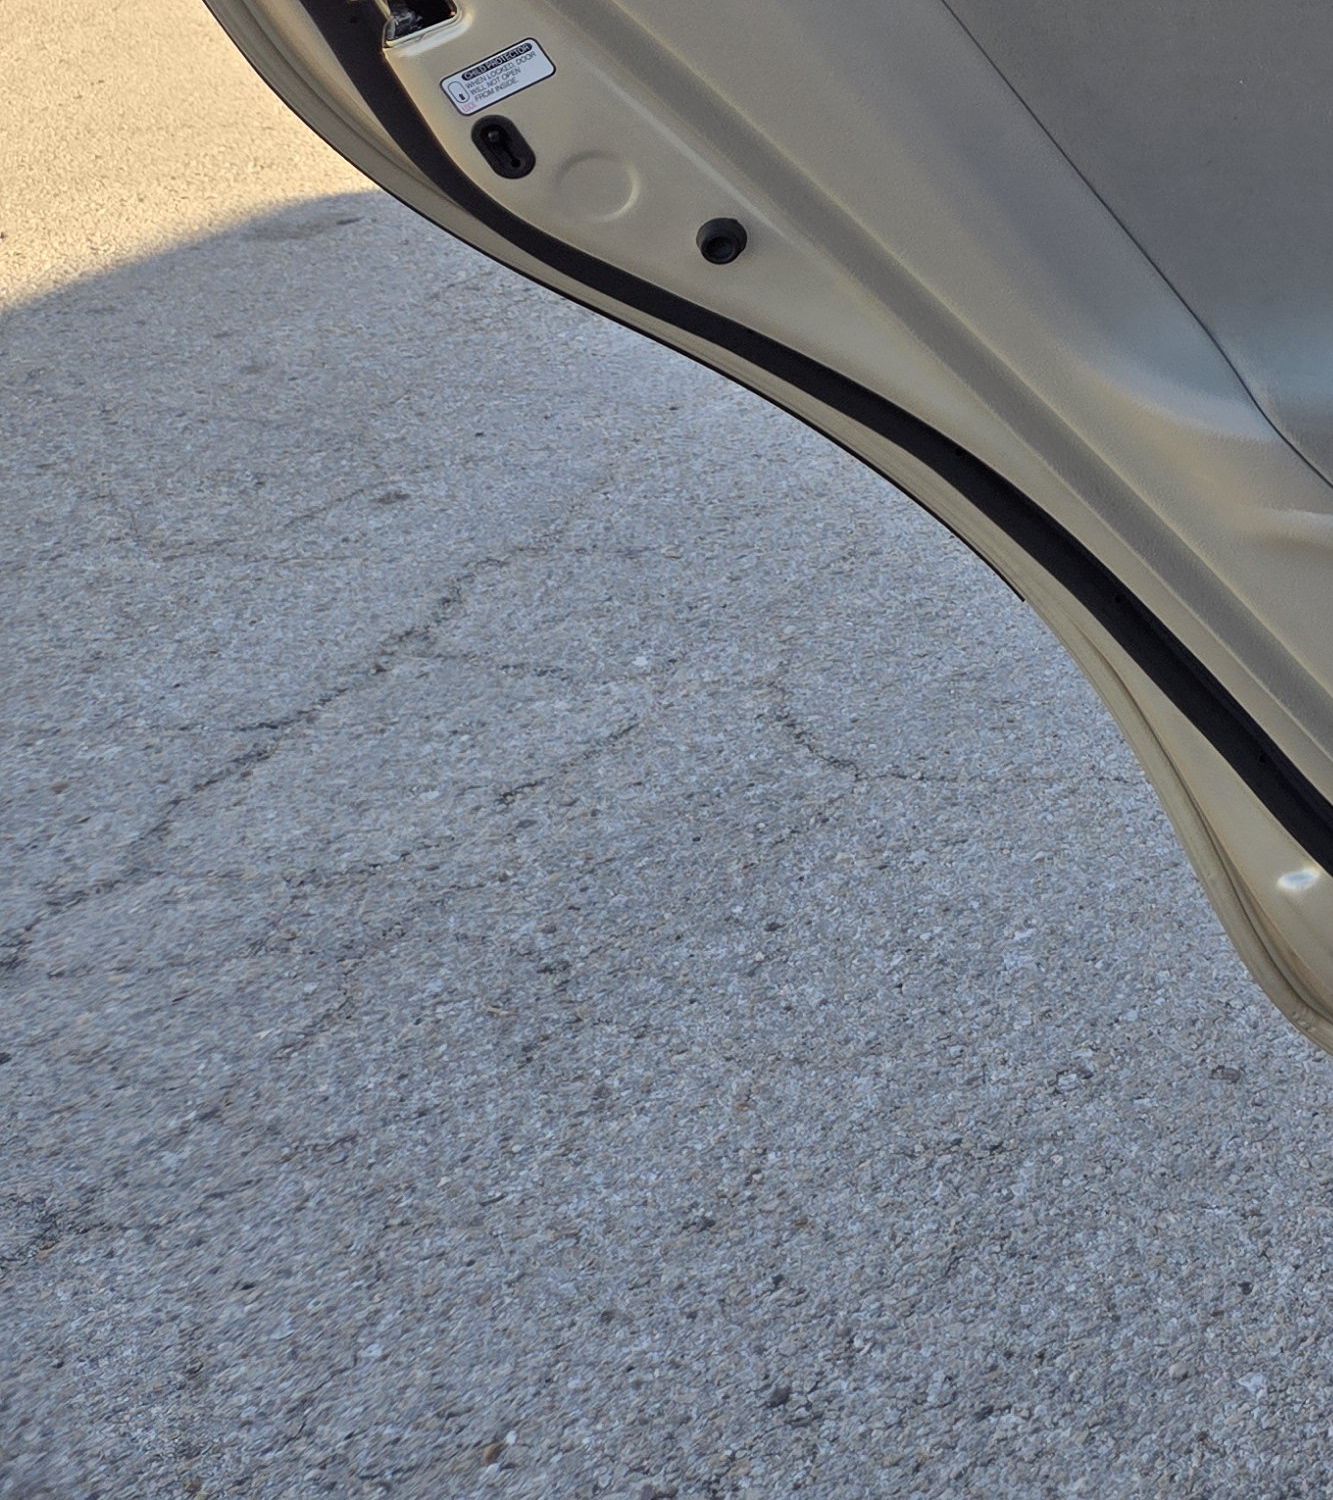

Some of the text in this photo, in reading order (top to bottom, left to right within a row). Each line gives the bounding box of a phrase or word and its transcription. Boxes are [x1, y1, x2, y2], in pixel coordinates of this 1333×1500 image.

[464, 44, 530, 80] CHILD PROTECTOR
[465, 74, 487, 89] WHEN
[516, 51, 537, 66] DOOR
[486, 76, 501, 88] NOT
[501, 67, 522, 80] OPEN
[474, 88, 495, 102] FROM
